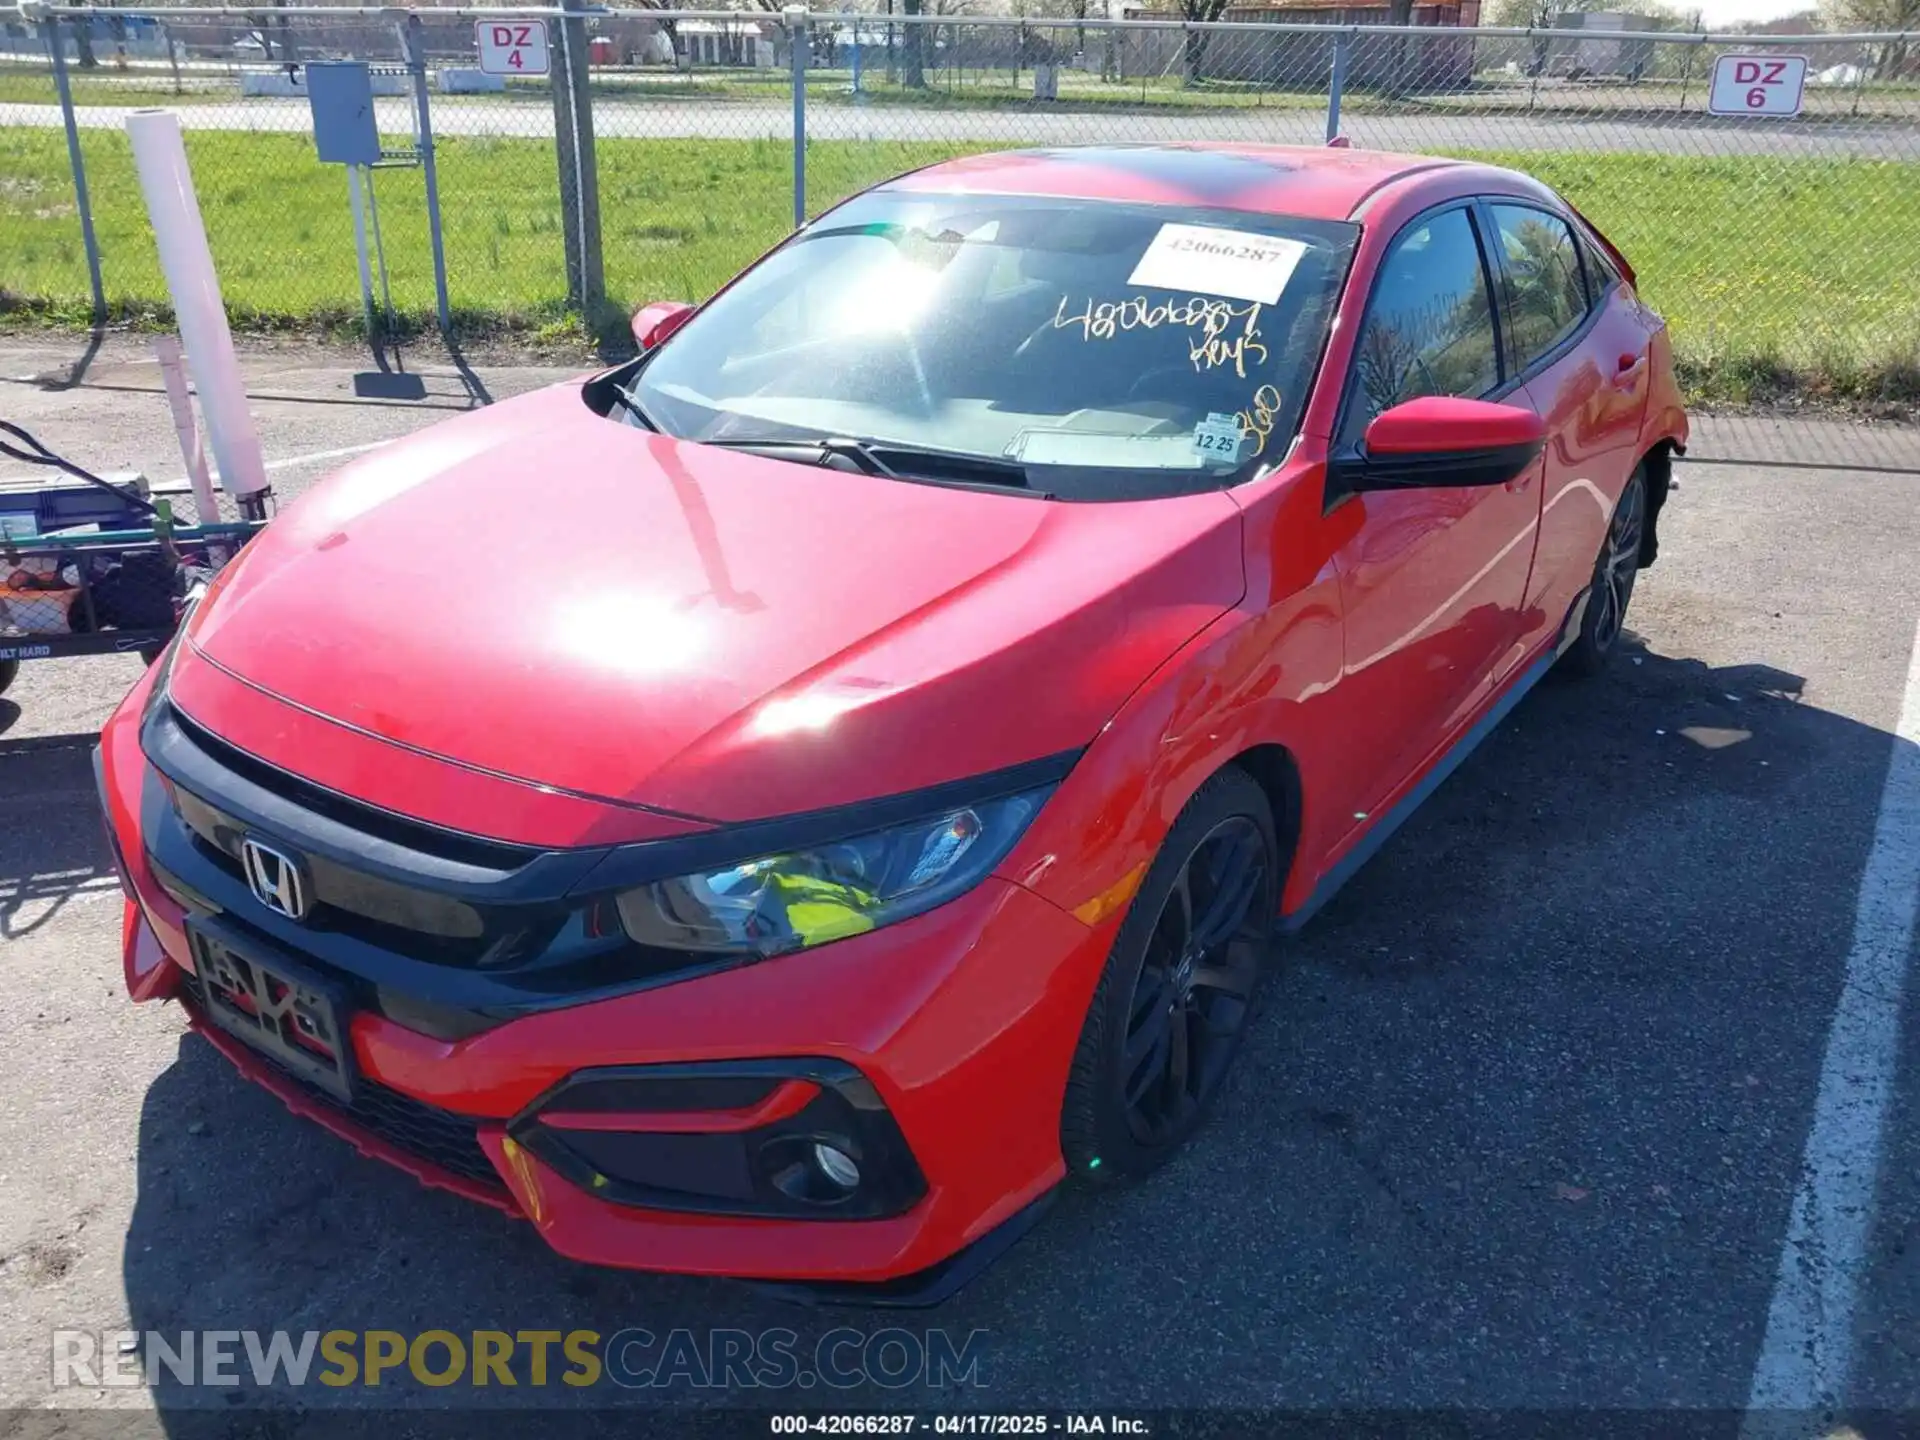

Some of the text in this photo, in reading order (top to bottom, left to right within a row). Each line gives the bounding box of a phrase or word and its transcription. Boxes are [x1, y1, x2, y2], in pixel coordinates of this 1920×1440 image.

[492, 26, 533, 47] DZ
[507, 49, 523, 69] 4
[1734, 62, 1787, 84] DZ
[1745, 87, 1767, 108] 6
[1195, 432, 1235, 452] 12 25
[18, 645, 50, 658] HARD
